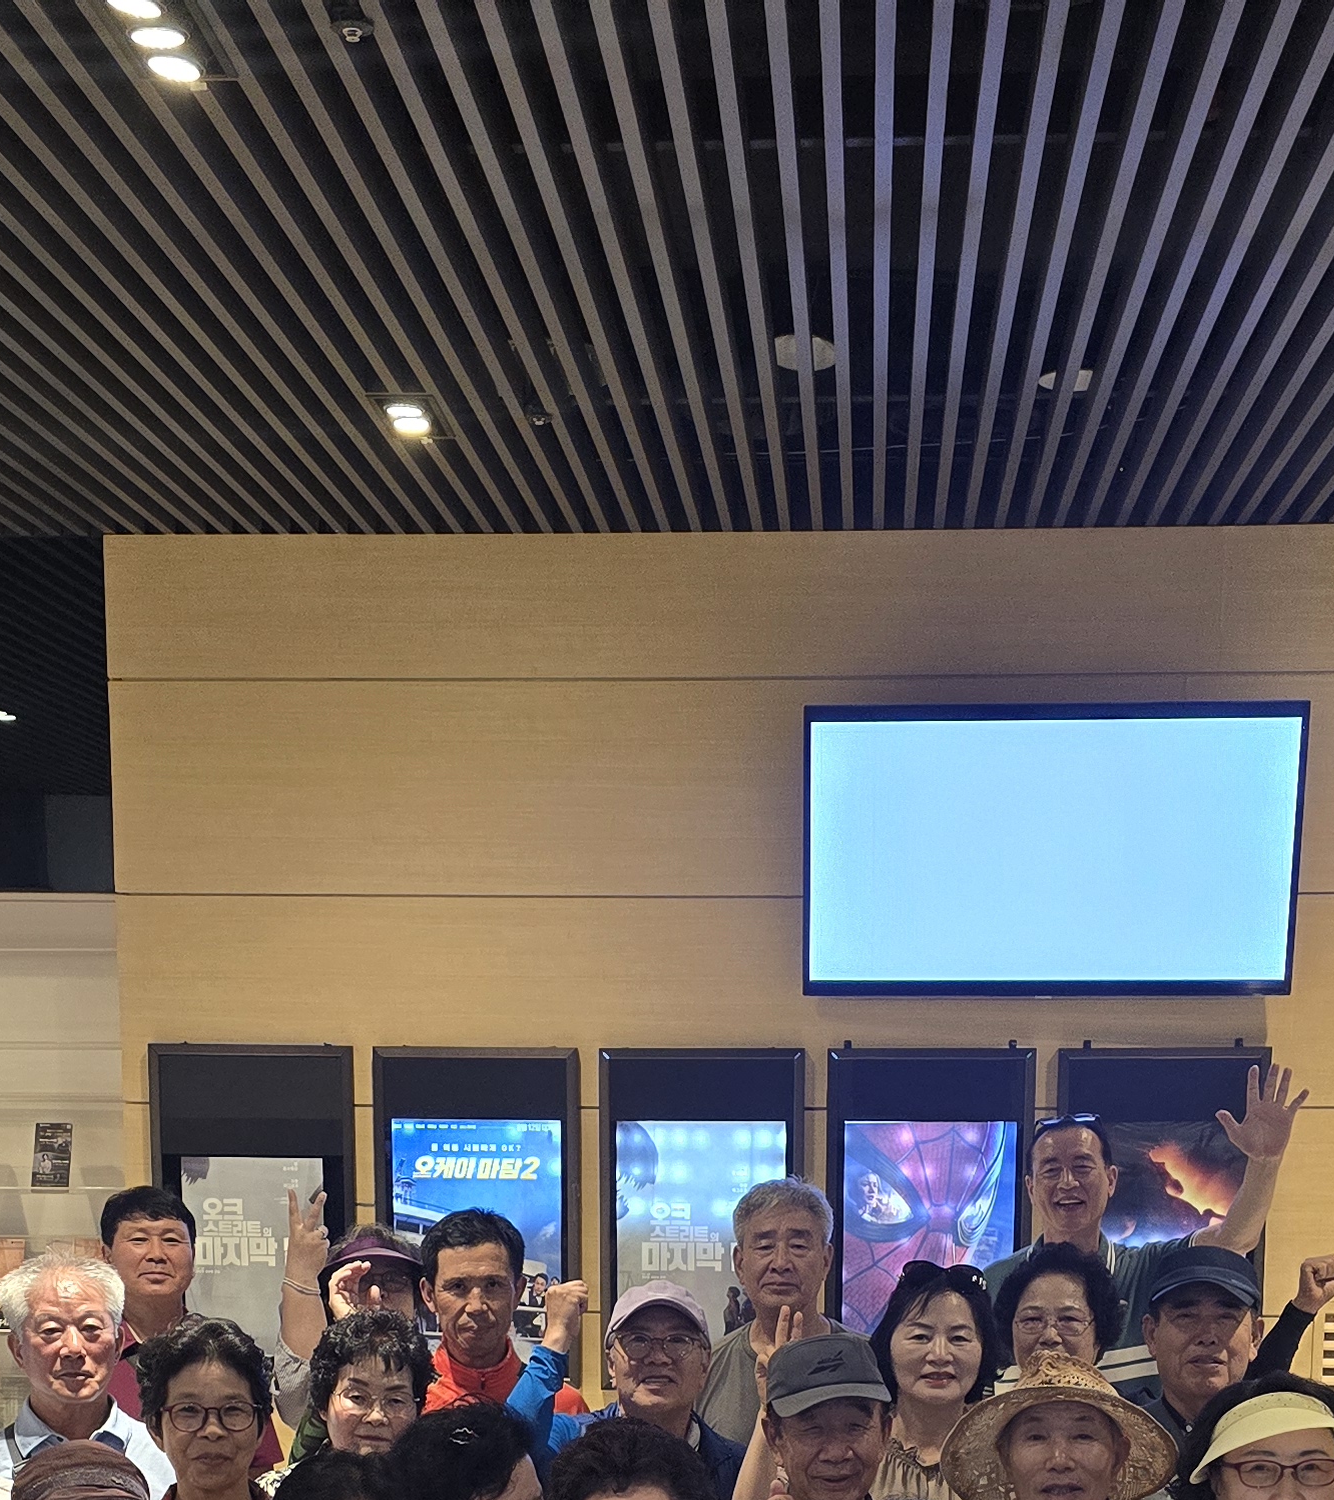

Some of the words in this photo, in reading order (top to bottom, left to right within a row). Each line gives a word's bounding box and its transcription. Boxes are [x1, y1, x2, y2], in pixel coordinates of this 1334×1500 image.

[203, 1197, 244, 1220] 오크
[650, 1202, 691, 1225] 오크
[195, 1237, 277, 1266] 마지막
[642, 1242, 724, 1272] 마지막
